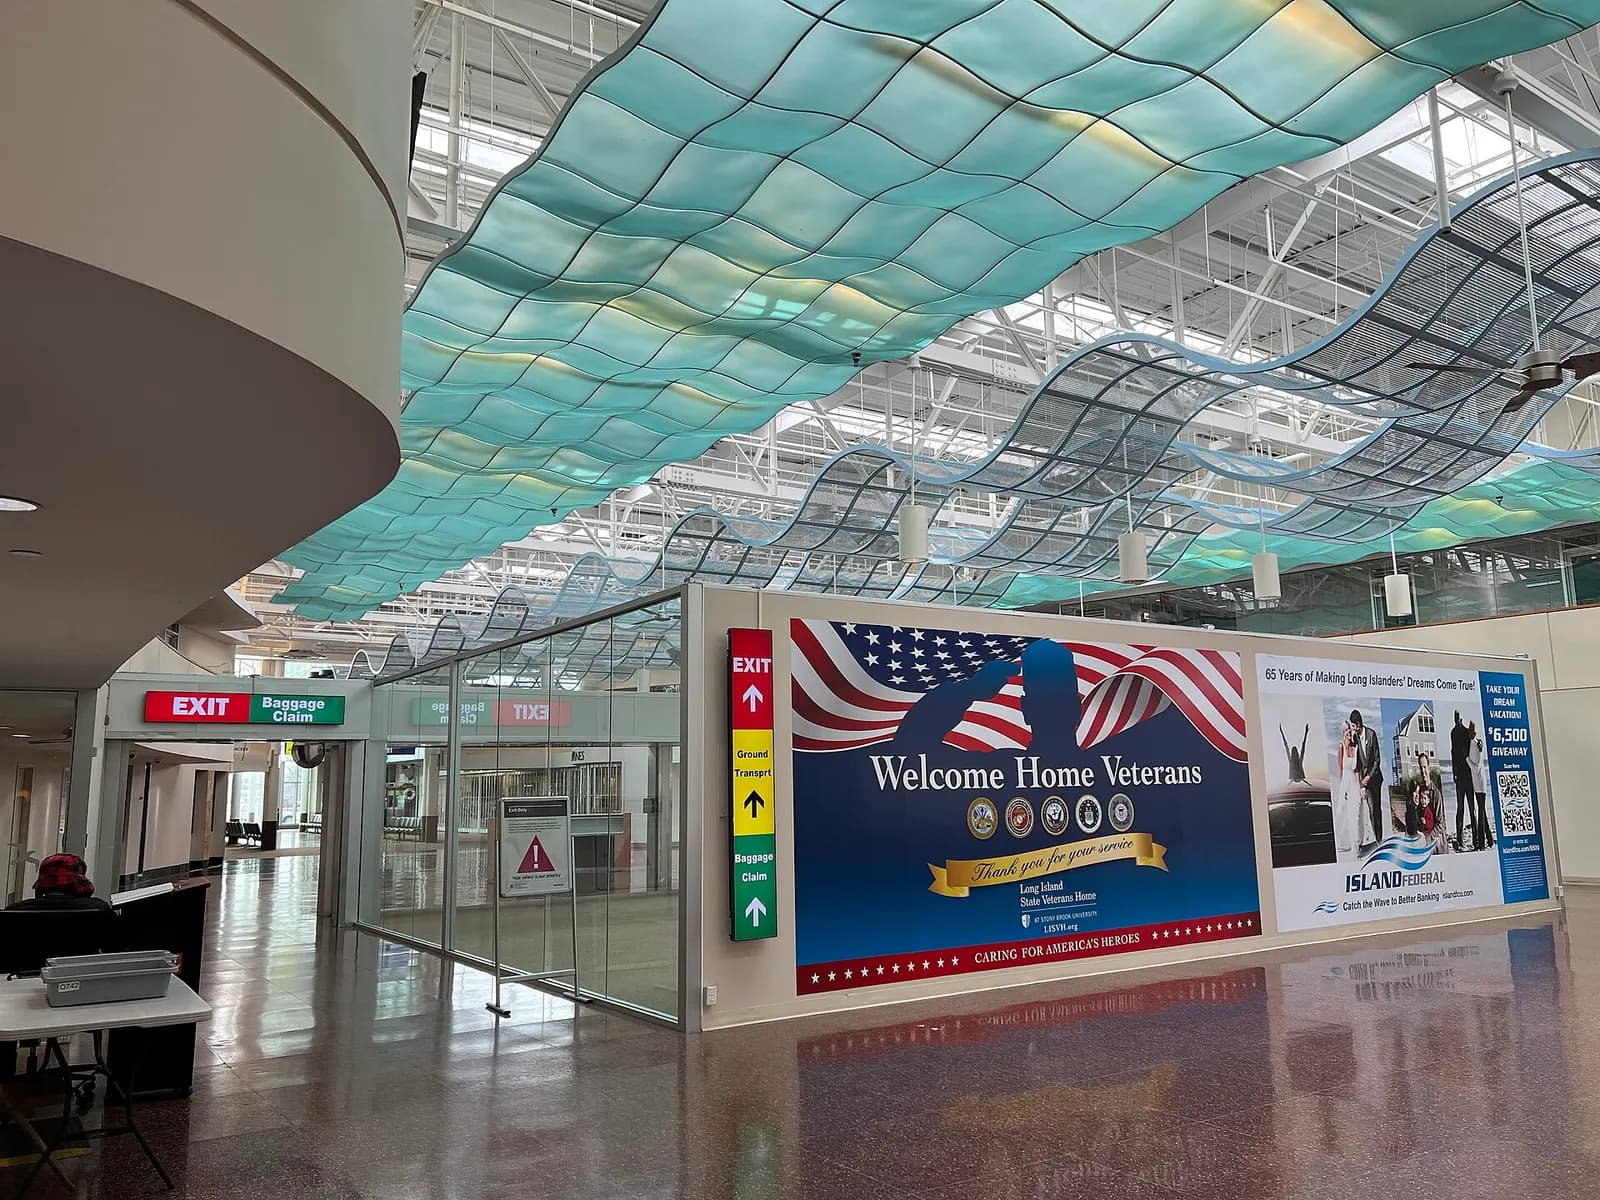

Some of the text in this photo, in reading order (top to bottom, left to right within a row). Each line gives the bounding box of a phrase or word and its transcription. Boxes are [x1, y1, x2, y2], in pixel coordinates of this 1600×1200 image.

[733, 657, 772, 673] EXIT
[1265, 668, 1277, 680] 65
[1278, 668, 1303, 682] Years
[1304, 670, 1314, 682] of
[1315, 671, 1346, 686] Making
[1347, 673, 1368, 687] Long
[1407, 676, 1435, 689] Dreams
[1436, 678, 1457, 690] Come
[1457, 679, 1475, 691] True!
[1486, 684, 1520, 694] TAKE YOUR
[172, 696, 230, 716] EXIT
[262, 696, 325, 711] Baggage
[1493, 698, 1516, 707] DREAM
[272, 711, 313, 722] Claim
[1488, 727, 1527, 744] $6,500
[737, 750, 769, 759] Ground
[1492, 747, 1528, 756] GIVEAWAY
[734, 769, 772, 779] Transprt
[869, 753, 1202, 791] Welcome Home Veterans
[735, 853, 774, 864] Baggage
[971, 837, 1134, 882] Thank you for your service
[742, 871, 768, 882] Claim
[1020, 880, 1064, 895] Long Island
[1020, 891, 1097, 908] State Veterans Home
[1342, 901, 1361, 911] Catch
[1362, 899, 1373, 909] the
[1373, 898, 1390, 908] Wave
[1391, 897, 1398, 906] to
[1398, 894, 1416, 905] Better
[1416, 892, 1440, 902] Banking
[974, 932, 1140, 964] CARING FOR AMERICA'S HEROES
